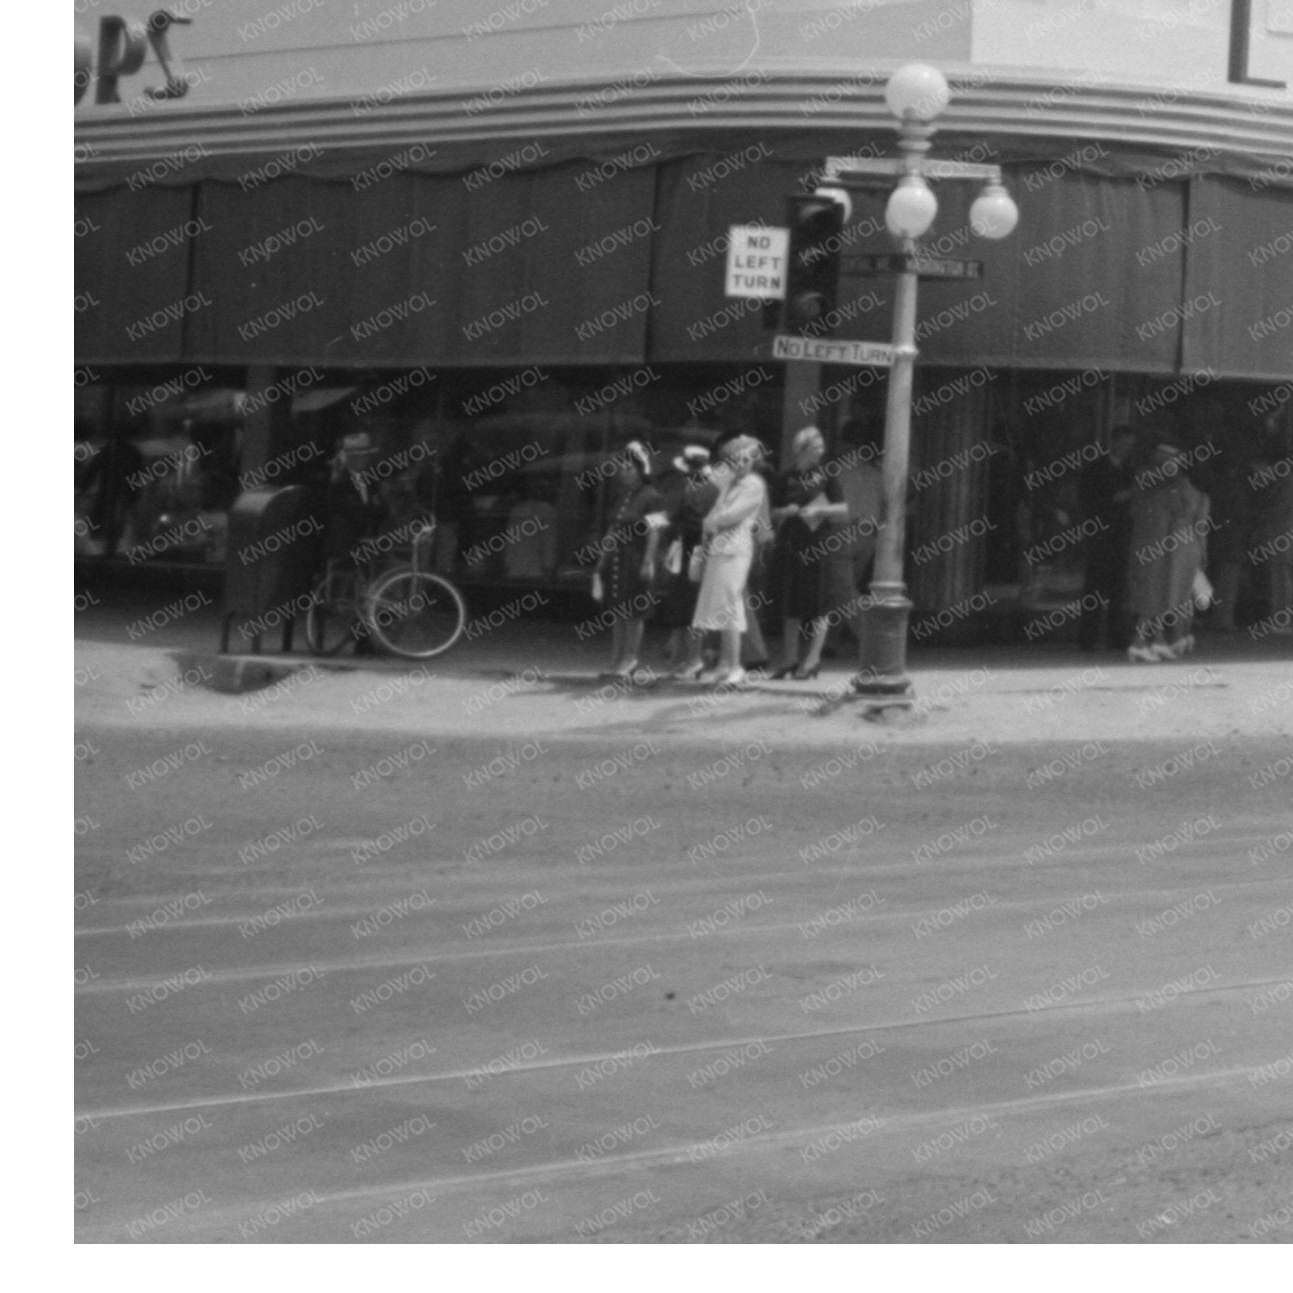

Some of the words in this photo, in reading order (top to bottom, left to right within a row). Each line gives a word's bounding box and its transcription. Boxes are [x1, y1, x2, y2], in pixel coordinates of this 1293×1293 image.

[746, 235, 771, 250] NO
[734, 256, 783, 270] LEFT
[732, 275, 781, 290] TURN
[803, 342, 848, 360] LEFT
[851, 344, 893, 364] TURN
